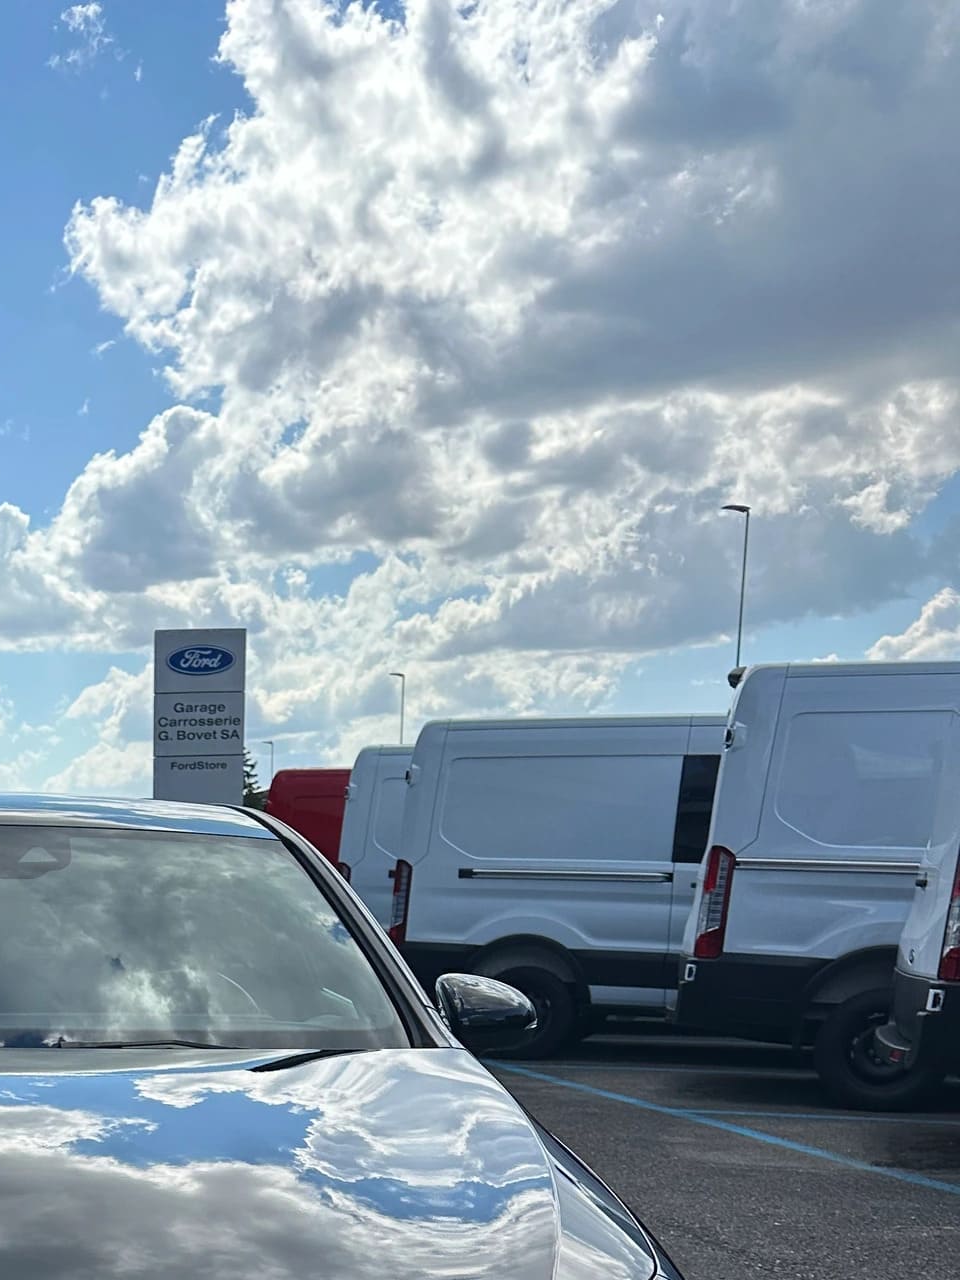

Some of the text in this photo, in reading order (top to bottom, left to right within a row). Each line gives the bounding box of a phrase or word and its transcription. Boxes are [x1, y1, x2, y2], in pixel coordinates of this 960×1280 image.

[179, 649, 222, 669] Ford
[173, 702, 226, 715] Garage
[158, 715, 241, 728] Carrosserie
[158, 729, 240, 741] G. Bovet SA
[170, 761, 227, 771] FordStore
